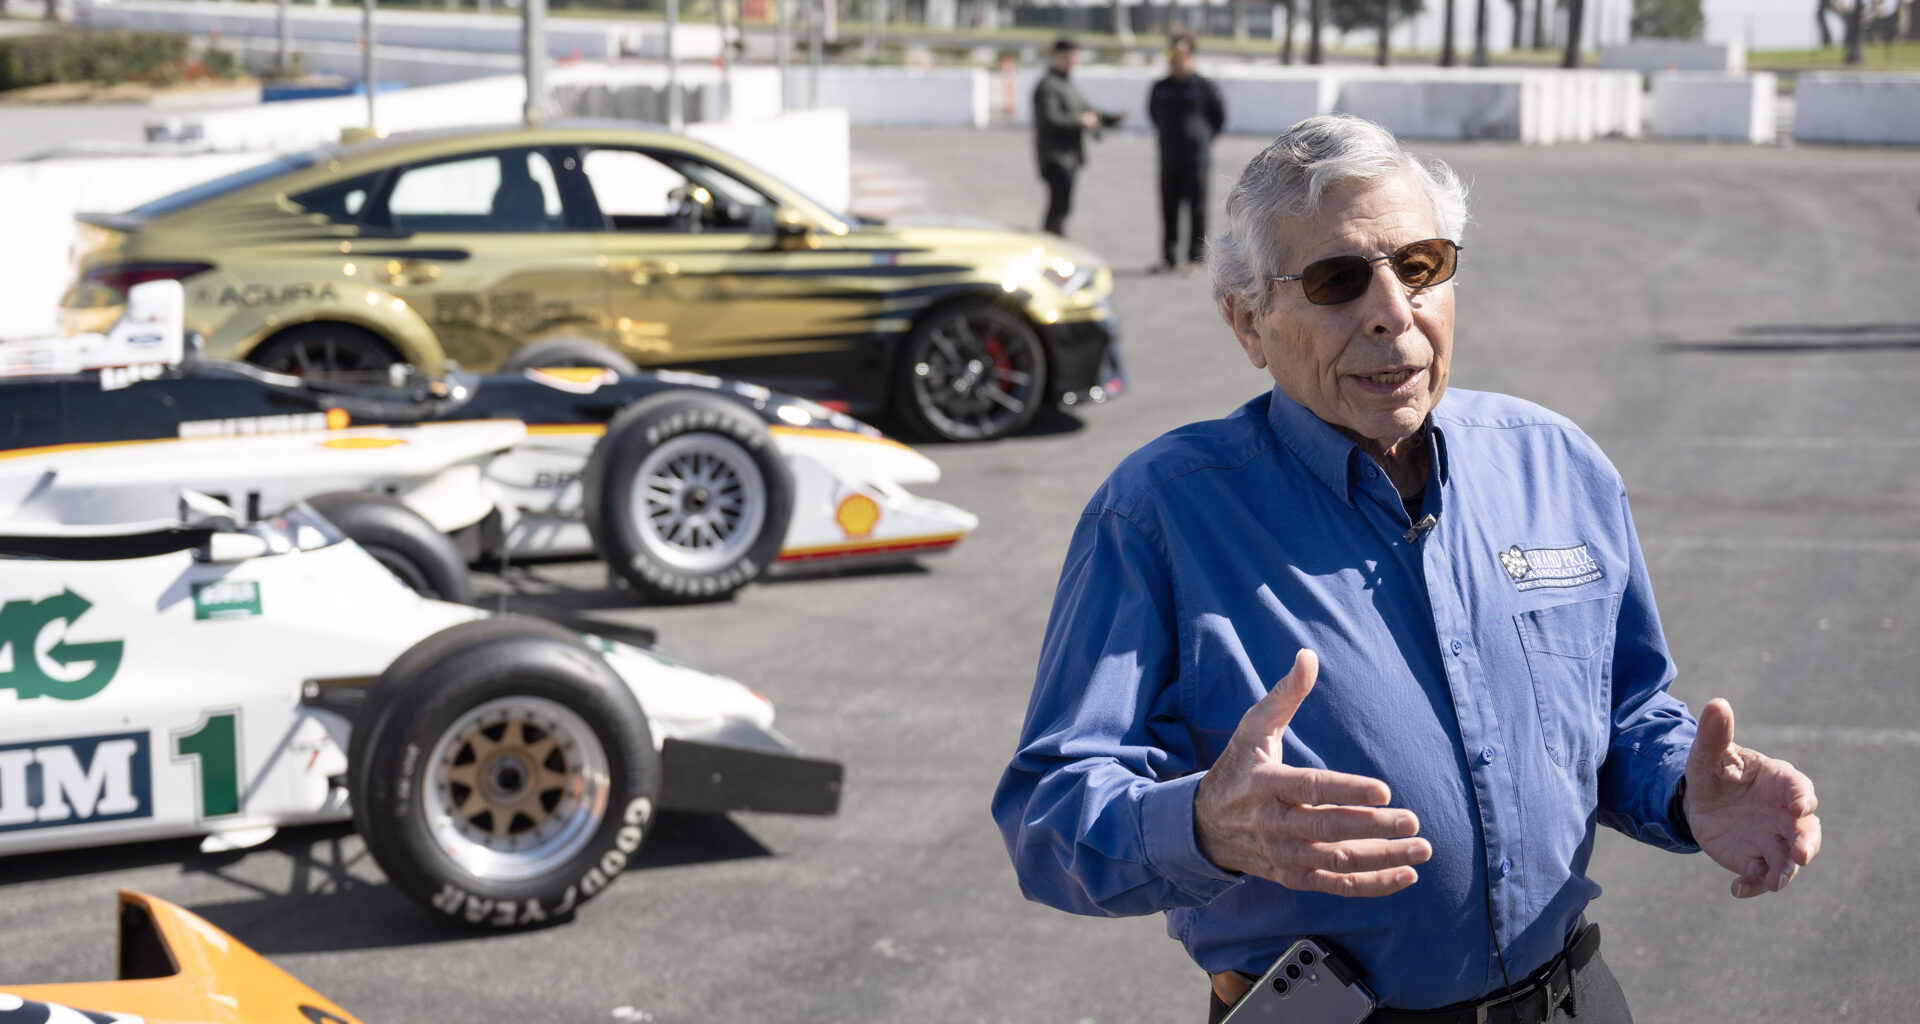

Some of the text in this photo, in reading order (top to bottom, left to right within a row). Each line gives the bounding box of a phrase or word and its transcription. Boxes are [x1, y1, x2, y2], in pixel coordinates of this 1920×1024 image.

[217, 282, 341, 308] ACURA
[1526, 545, 1594, 569] GRAND PRIX
[1517, 571, 1602, 589] OF LONG BEACH
[1529, 563, 1597, 579] ASSOCIATION
[173, 709, 244, 823] 1
